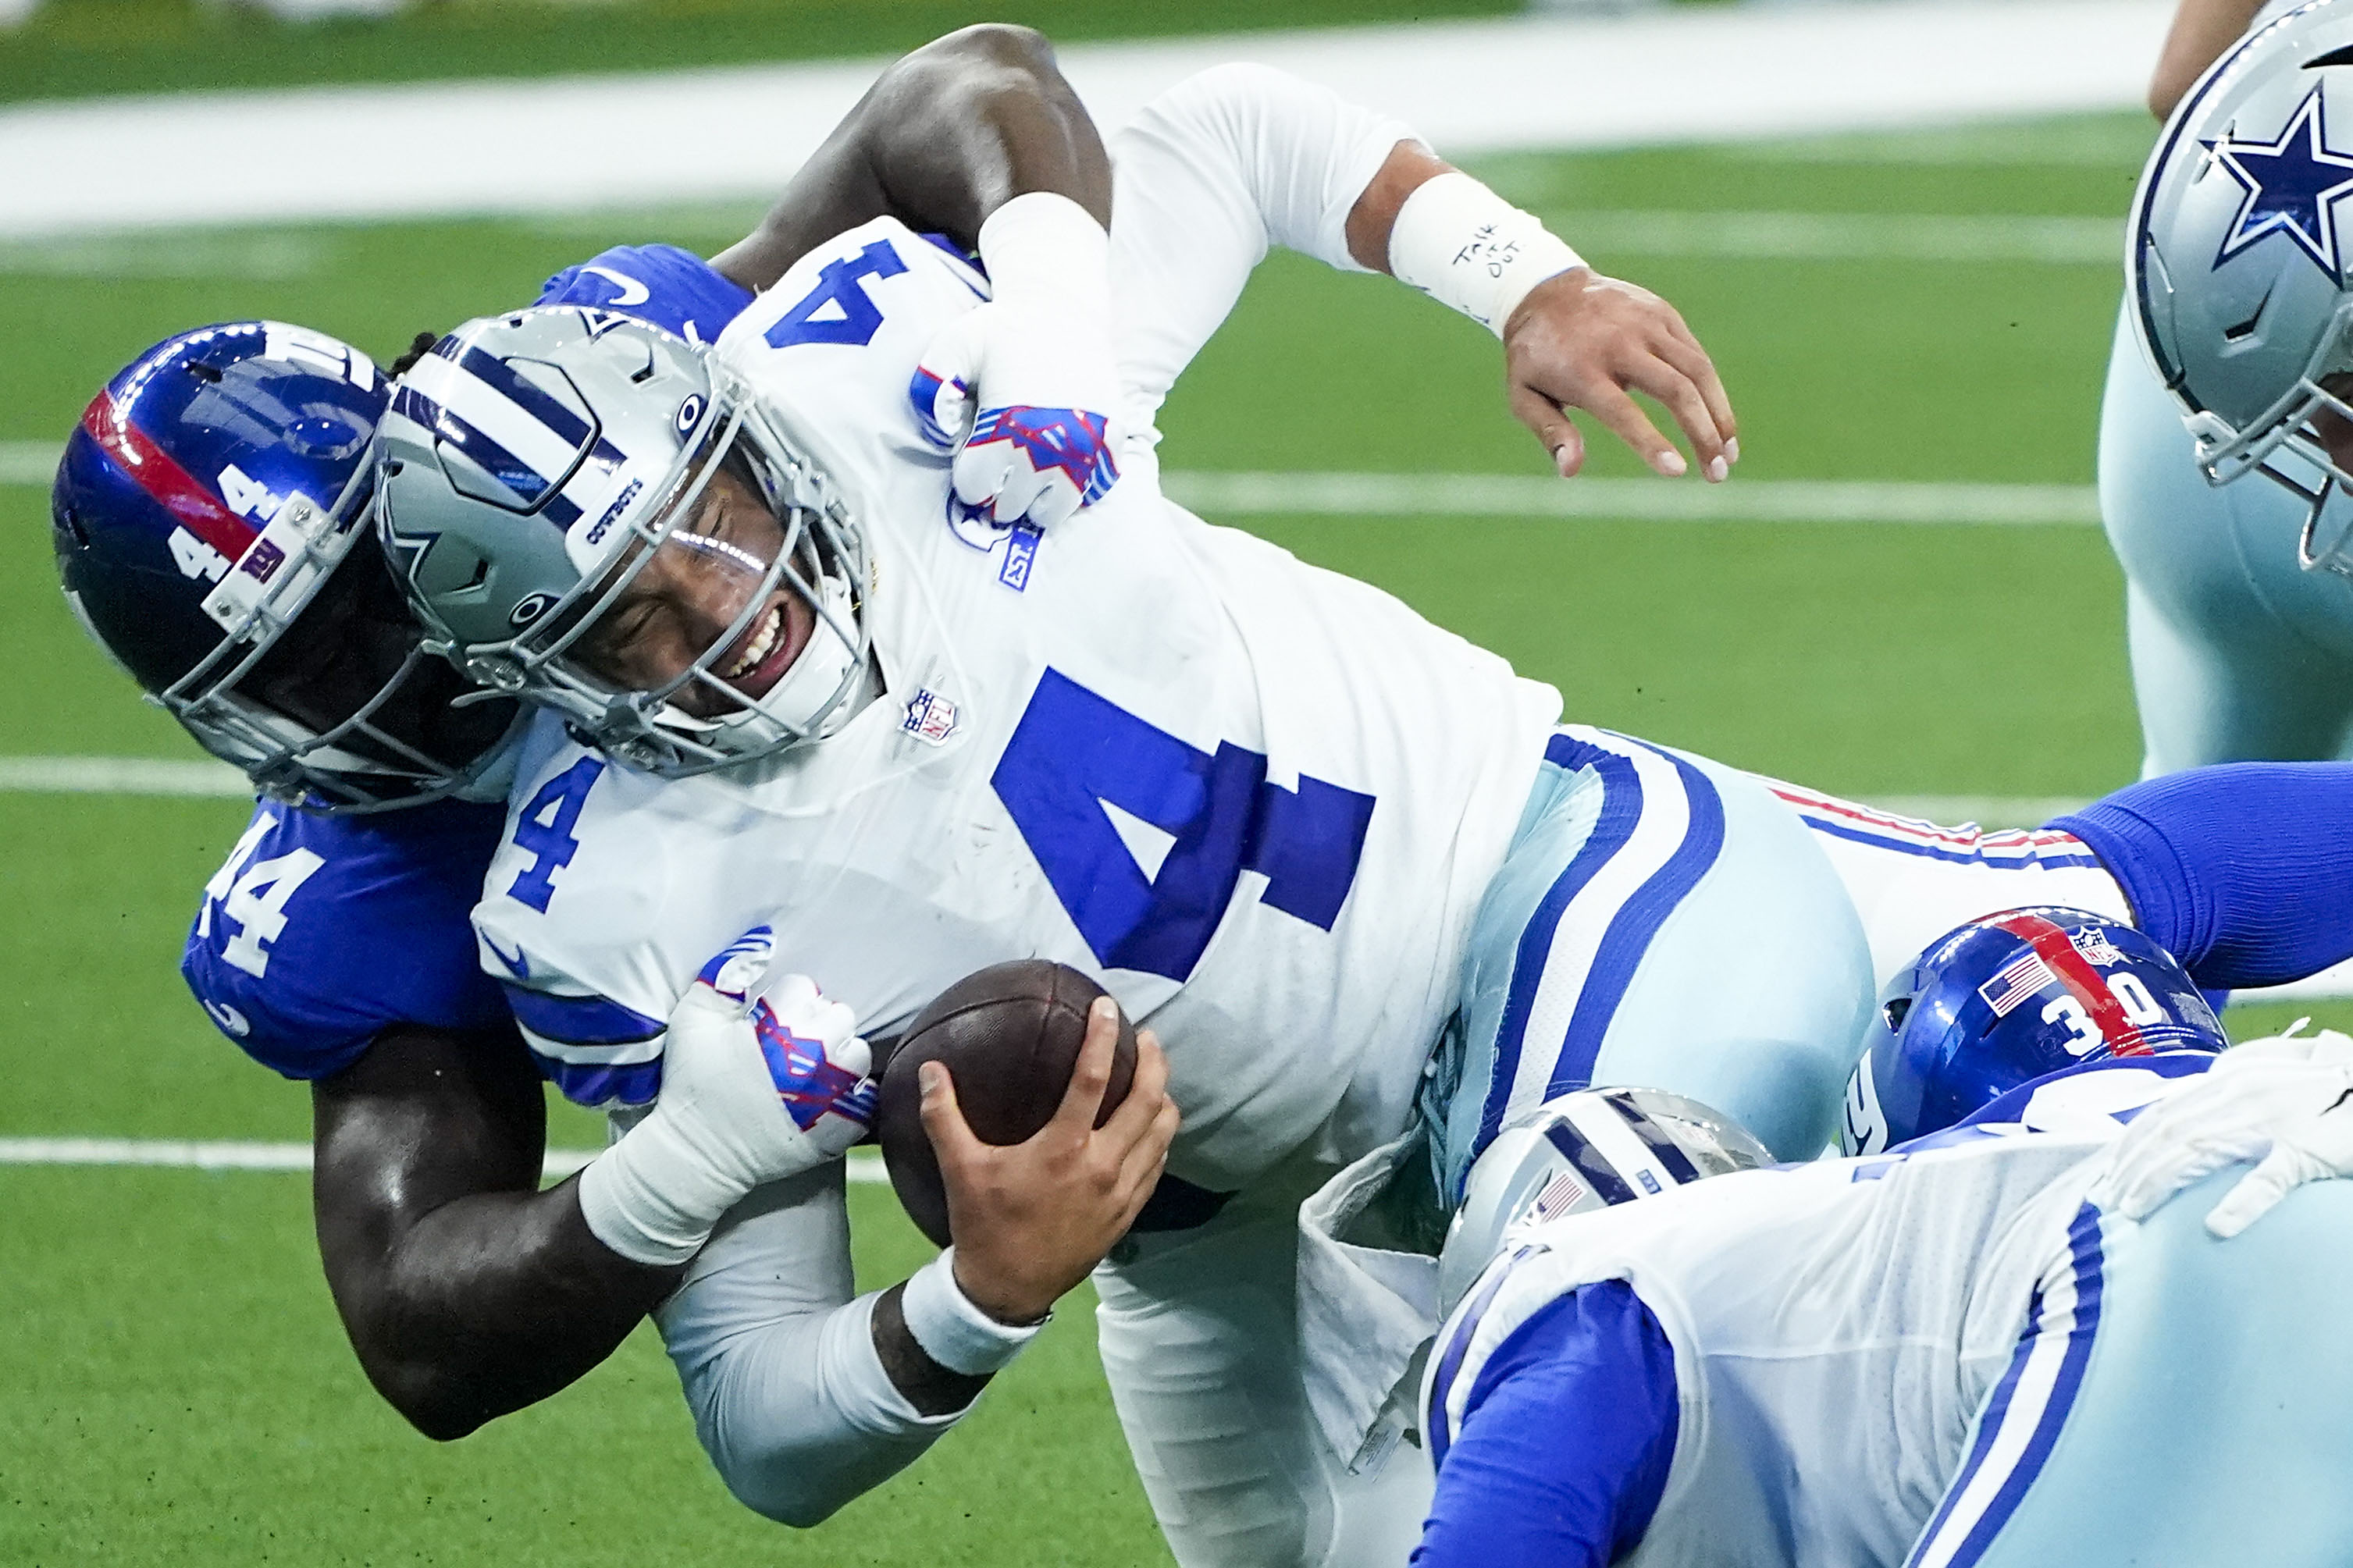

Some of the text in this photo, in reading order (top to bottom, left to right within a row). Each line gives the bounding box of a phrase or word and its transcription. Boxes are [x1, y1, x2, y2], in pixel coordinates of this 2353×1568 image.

[764, 239, 910, 348] 4
[586, 477, 644, 545] COWBOYS
[507, 756, 605, 915] 4
[990, 665, 1377, 983] 4
[2083, 945, 2114, 962] NFL
